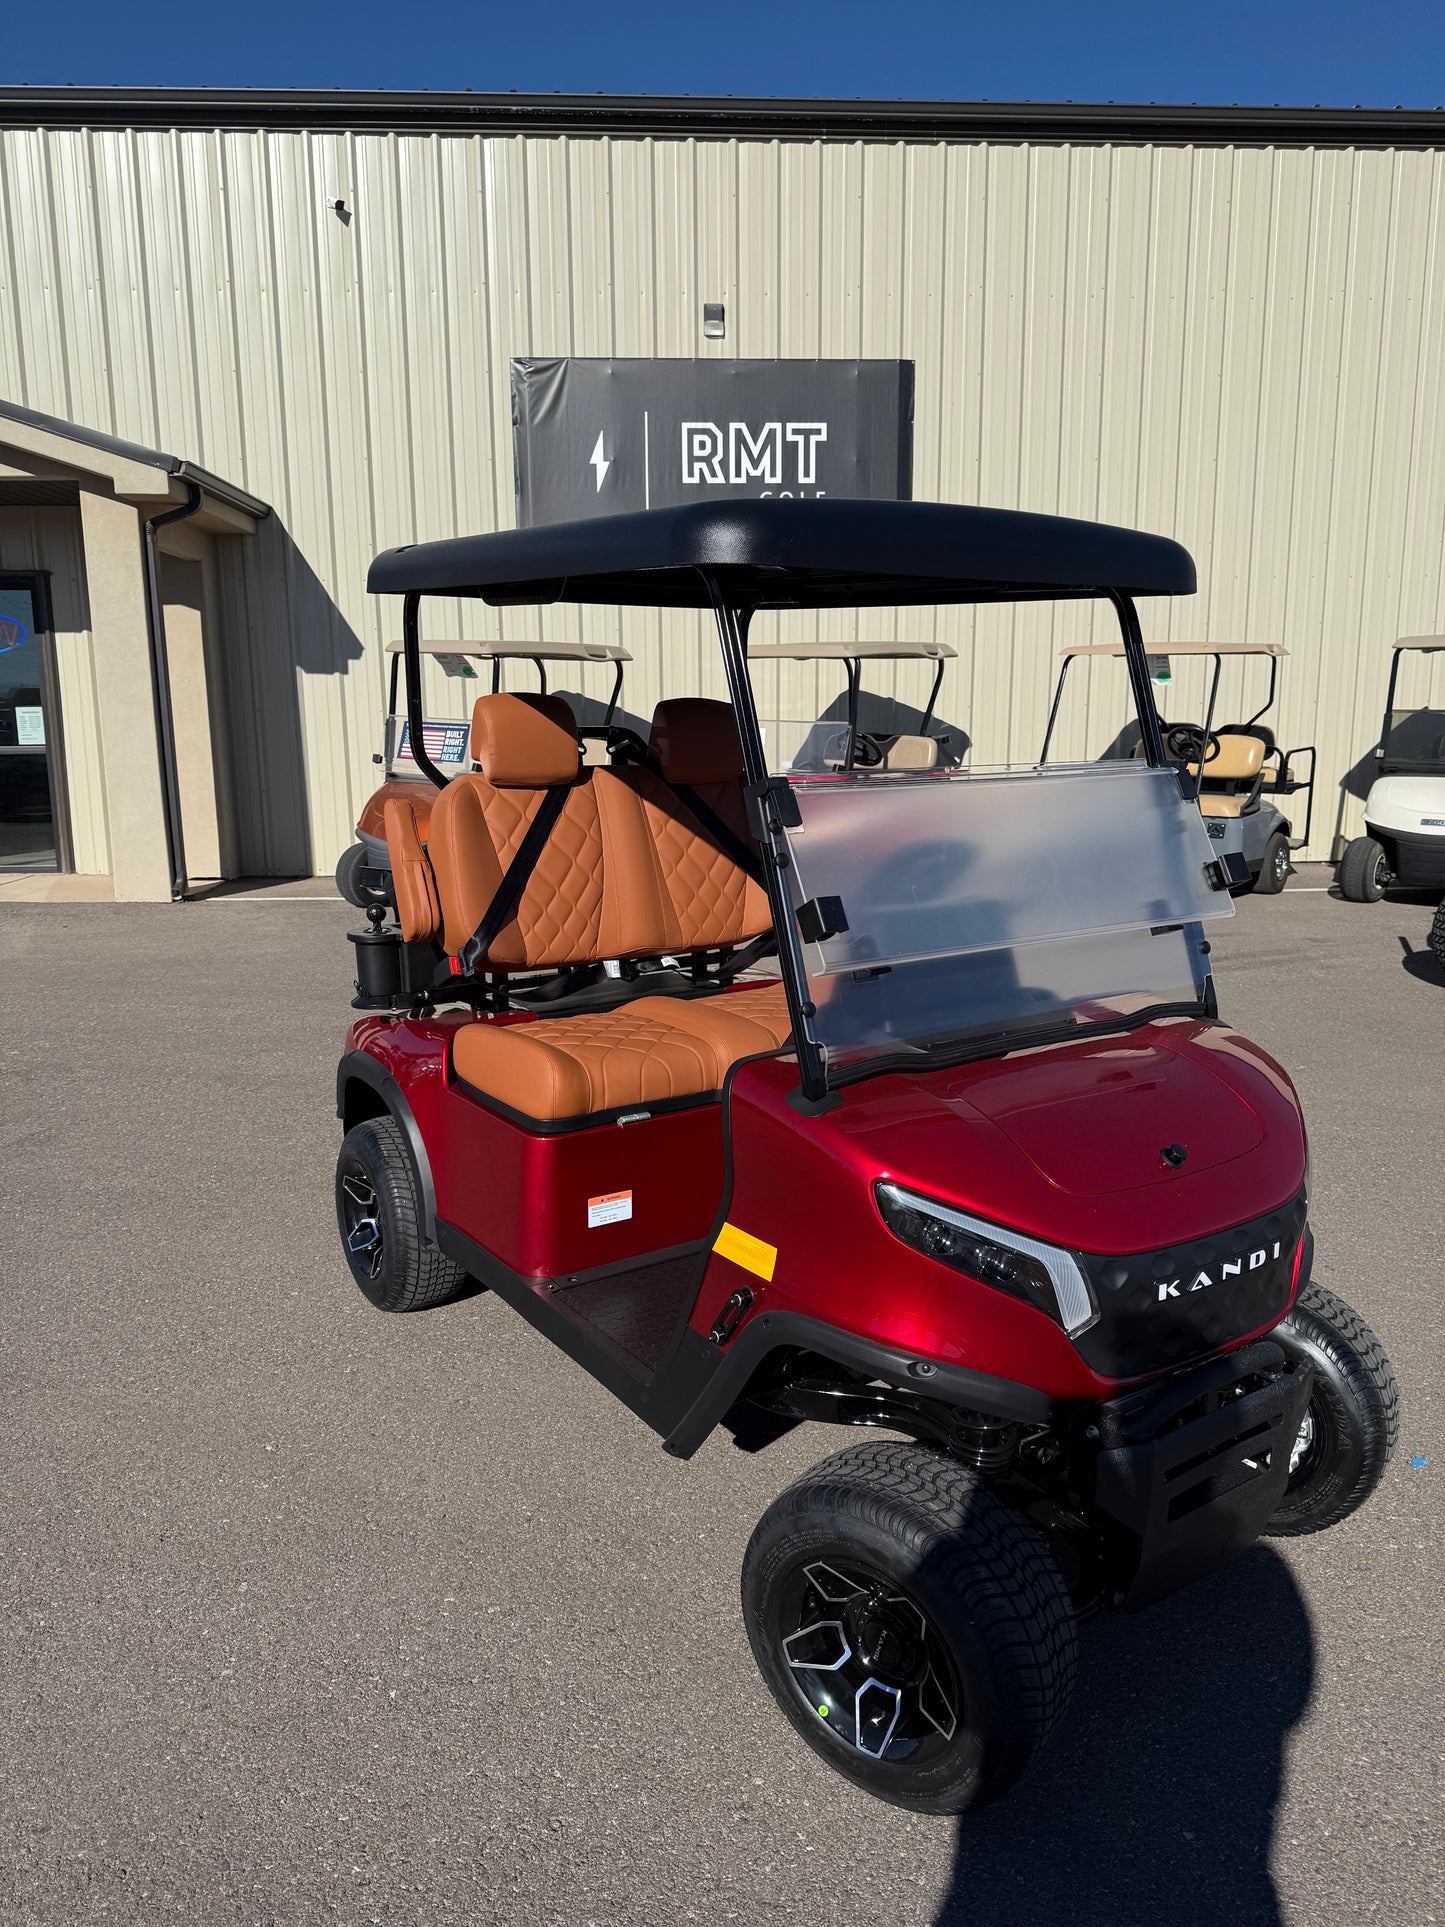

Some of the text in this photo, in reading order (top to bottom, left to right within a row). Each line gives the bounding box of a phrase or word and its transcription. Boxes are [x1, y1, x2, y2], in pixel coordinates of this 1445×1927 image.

[681, 422, 828, 484] RMT
[446, 730, 464, 738] BUILT
[444, 738, 464, 746] RIGHT.
[443, 746, 462, 754] RIGHT
[1157, 1241, 1281, 1301] KANDI
